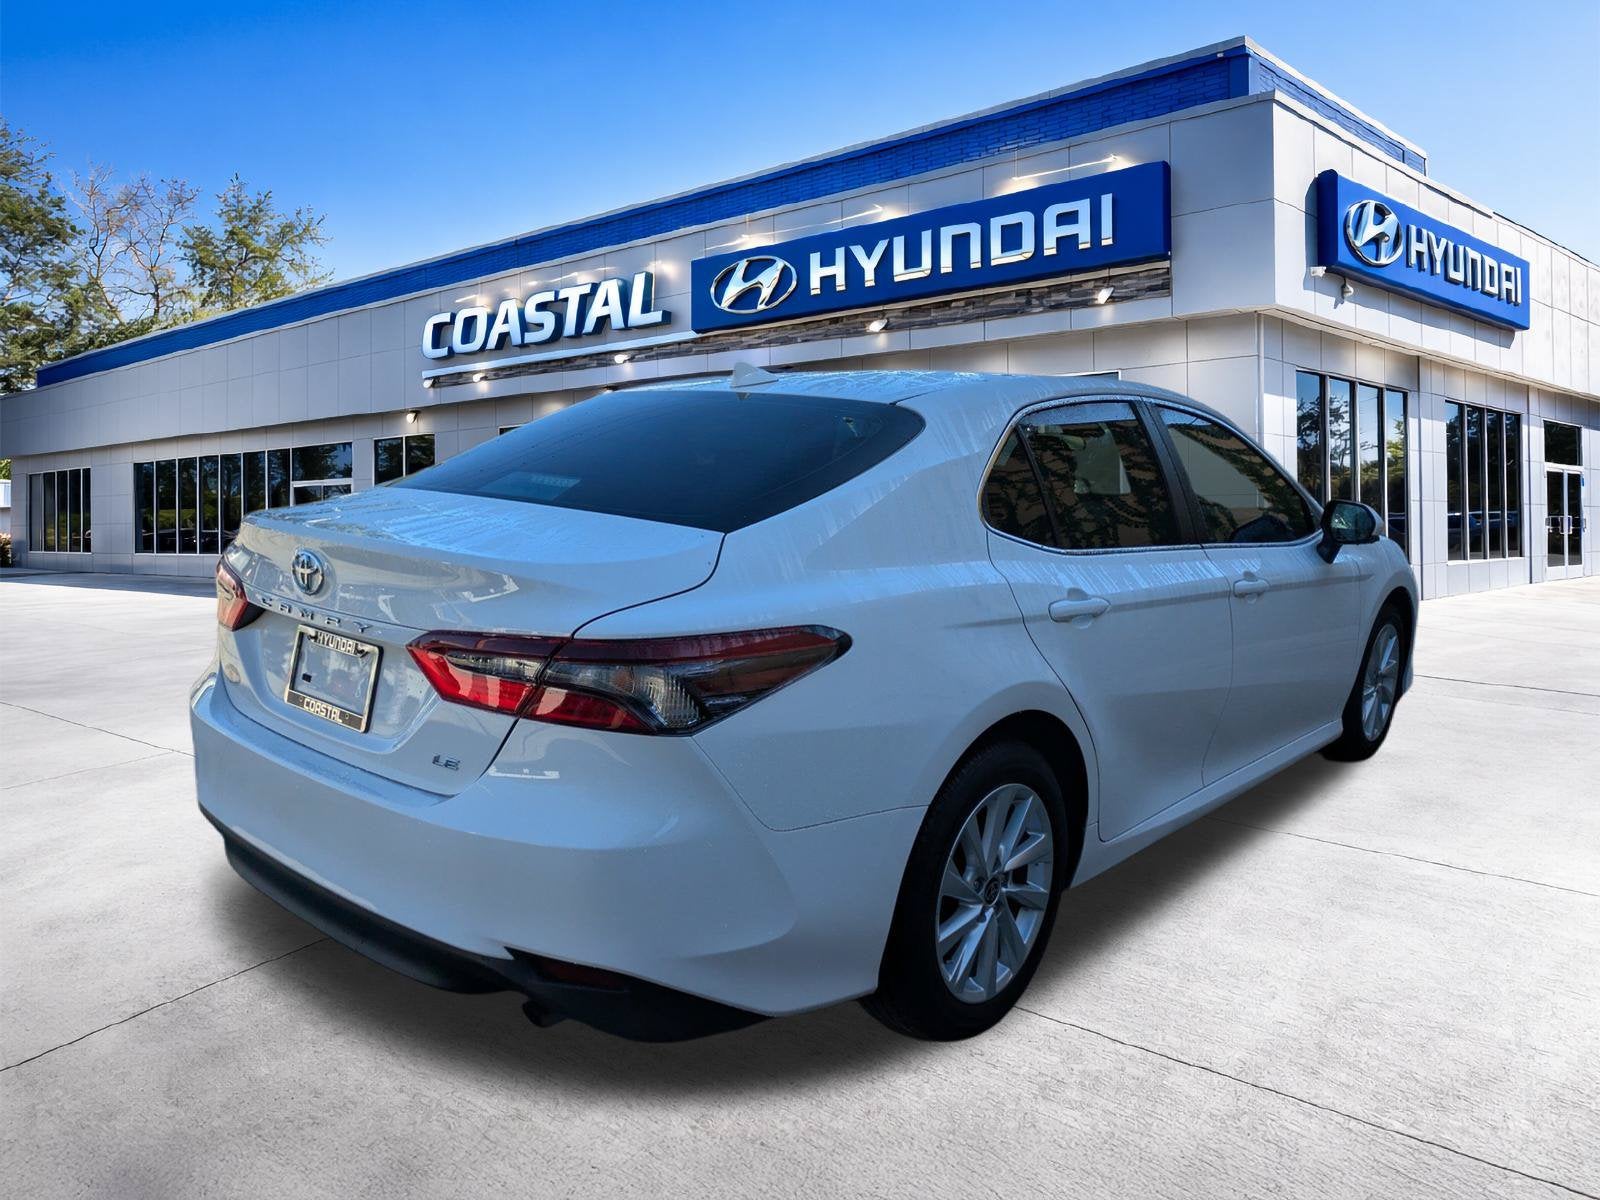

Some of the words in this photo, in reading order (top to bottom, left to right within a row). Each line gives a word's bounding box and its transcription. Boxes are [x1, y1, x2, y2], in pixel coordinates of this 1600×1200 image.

[809, 194, 1113, 295] HYUNDAI
[1406, 224, 1522, 306] HYUNDAI
[421, 272, 668, 360] COASTAL
[261, 597, 373, 633] CAMRY
[316, 630, 358, 655] HYUNDAI
[303, 697, 343, 723] COASTAL
[432, 755, 462, 772] LE
